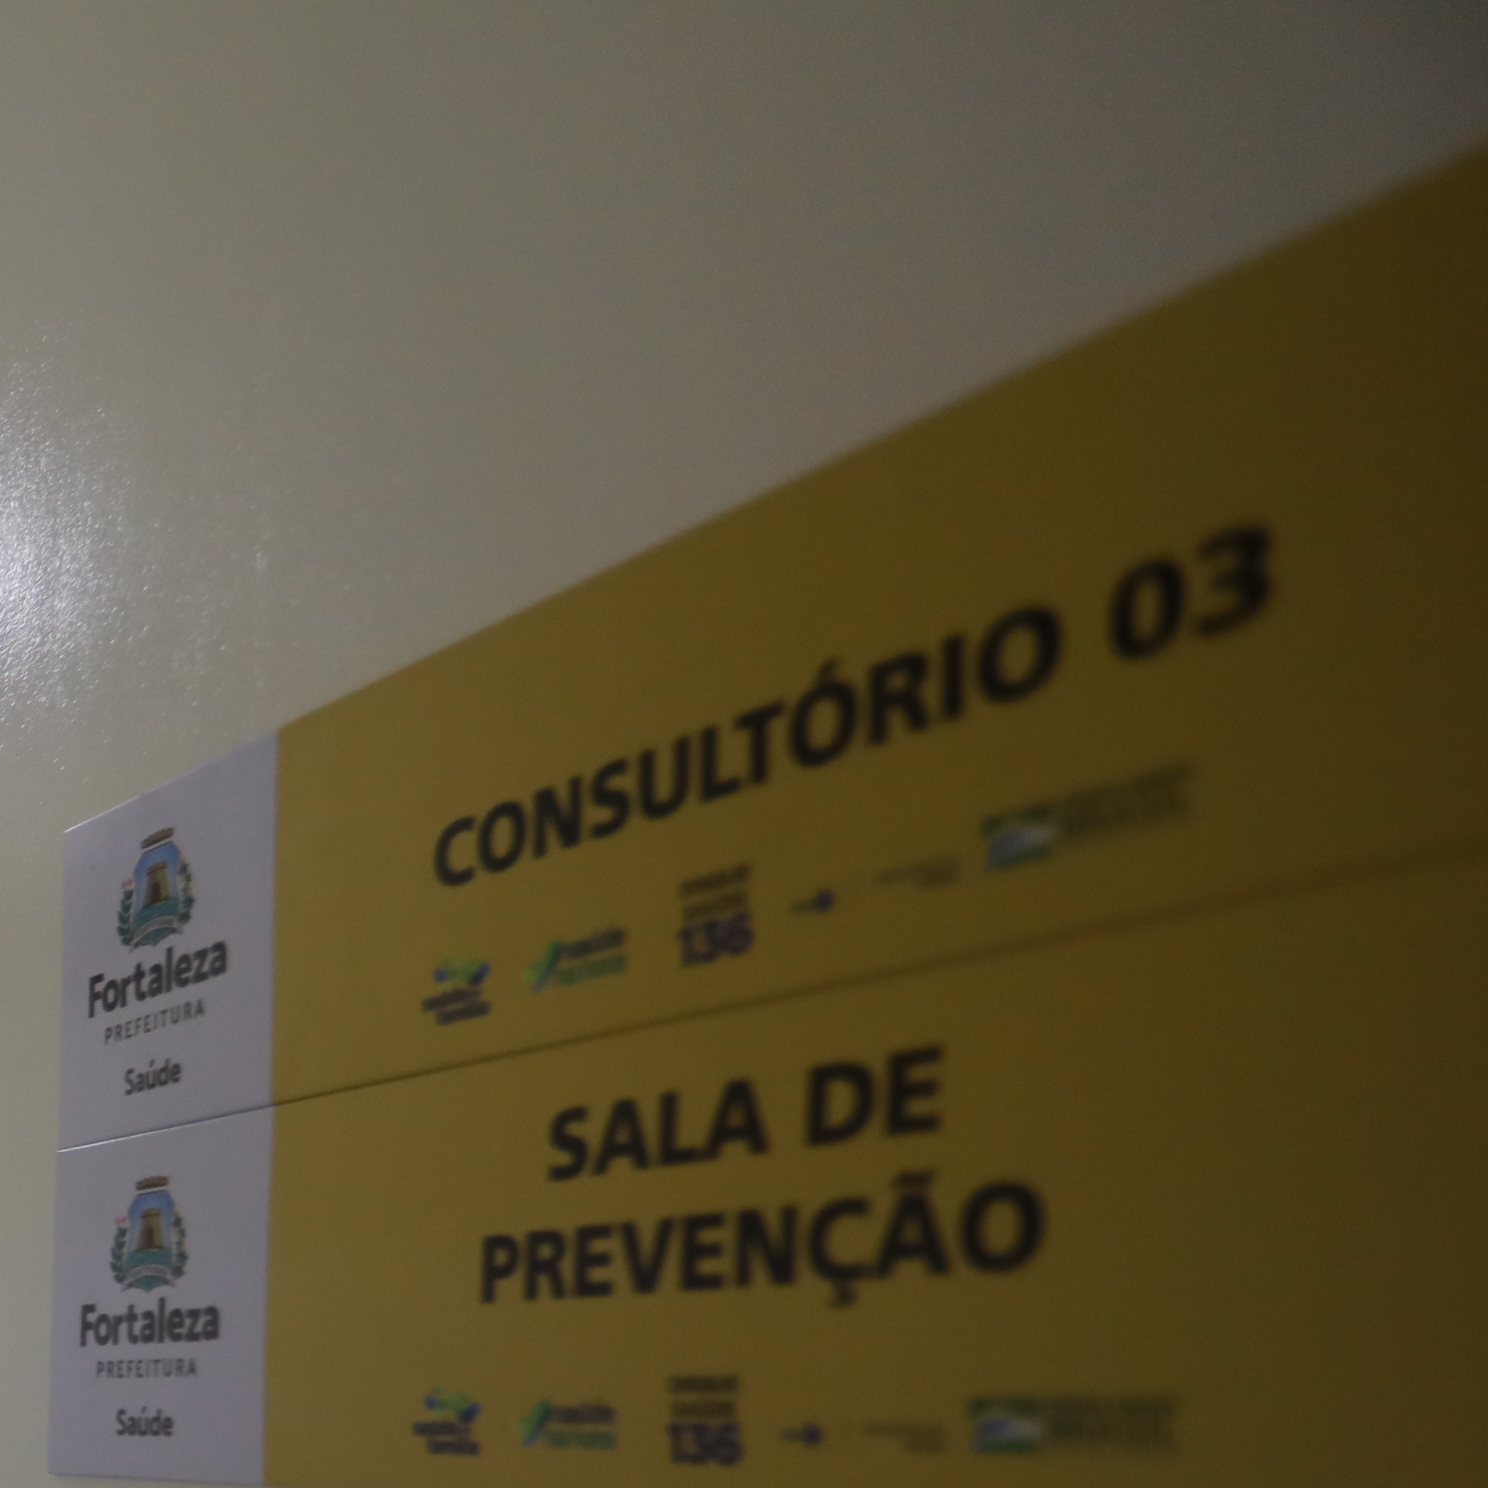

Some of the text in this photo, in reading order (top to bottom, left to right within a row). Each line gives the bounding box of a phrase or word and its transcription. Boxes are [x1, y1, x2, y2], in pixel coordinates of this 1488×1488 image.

[433, 605, 1062, 887] CONSULTÓRIO
[1105, 524, 1272, 661] 03
[88, 939, 228, 1017] Fortaleza
[104, 998, 205, 1045] PREFEITURA
[125, 1057, 181, 1095] Saúde
[546, 1045, 944, 1182] SALA DE
[480, 1171, 1045, 1308] PREVENÇÃO
[80, 1297, 220, 1347] Fortaleza
[96, 1356, 197, 1379] PREFEITURA
[116, 1406, 173, 1438] Saúde
